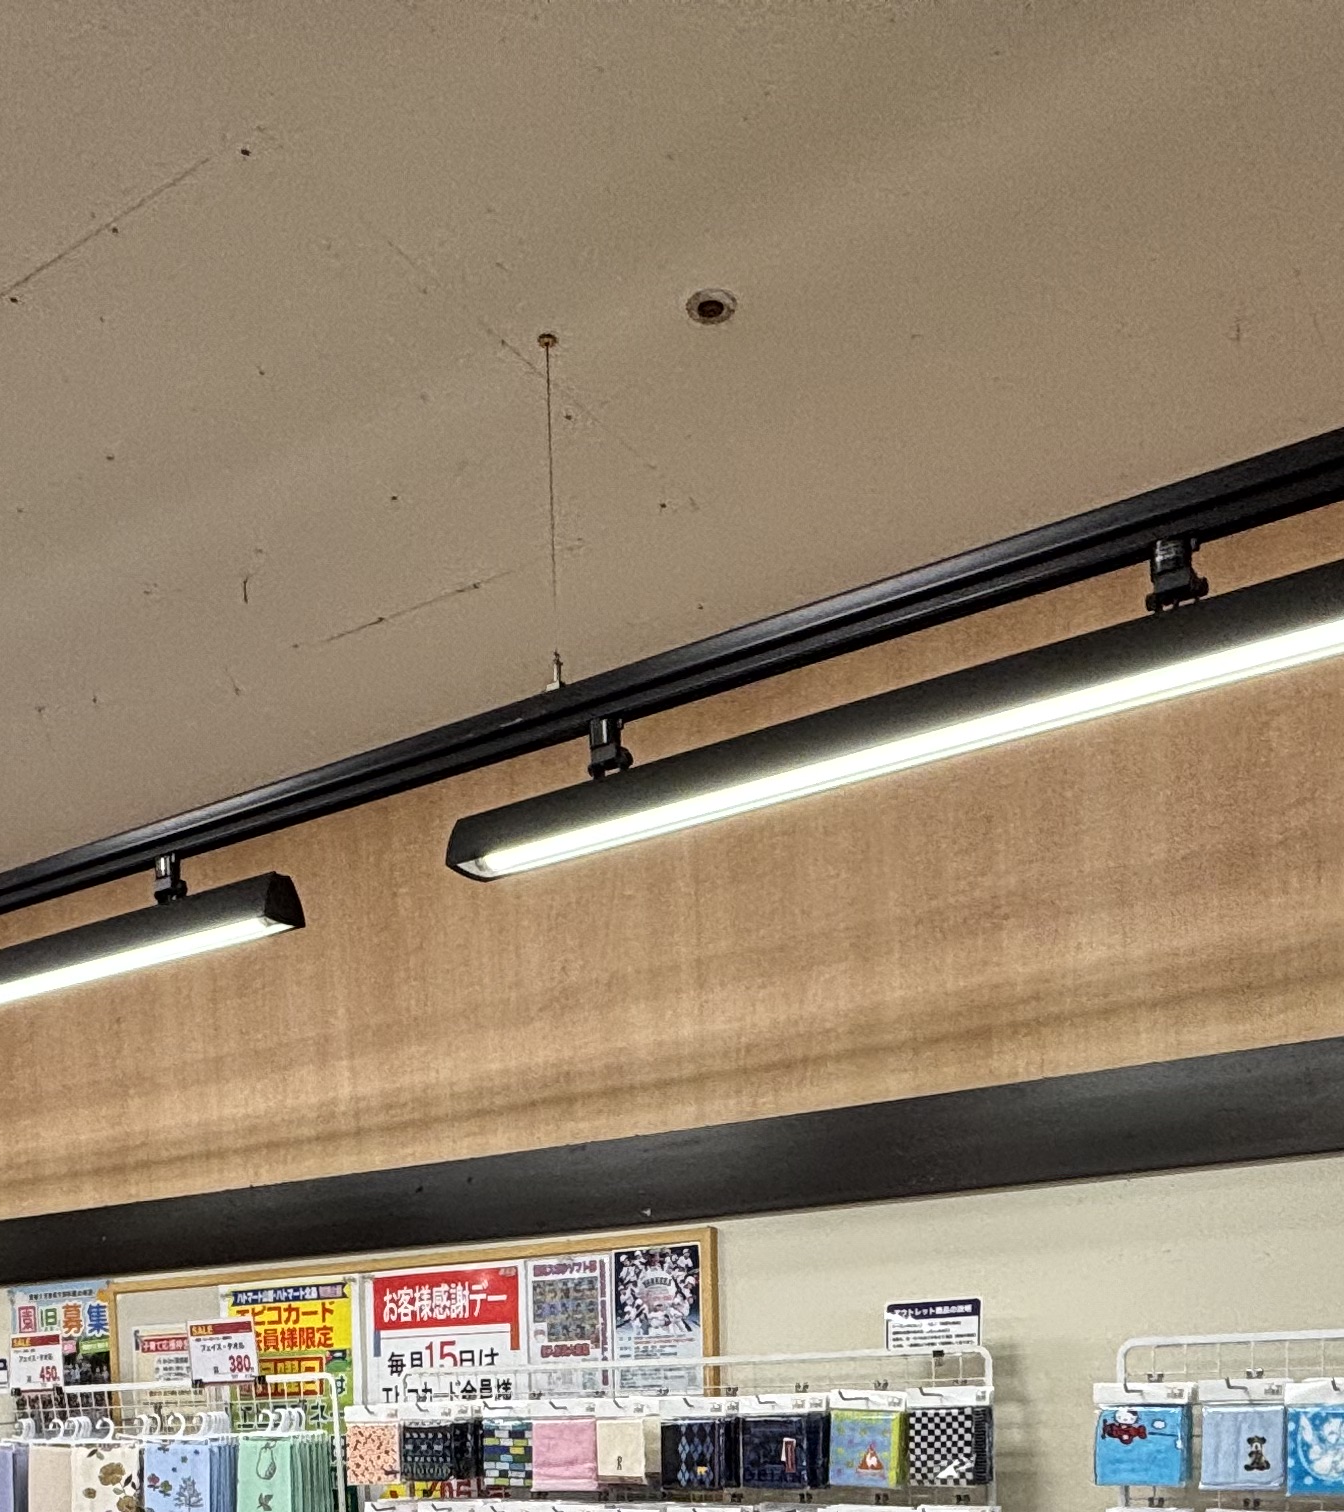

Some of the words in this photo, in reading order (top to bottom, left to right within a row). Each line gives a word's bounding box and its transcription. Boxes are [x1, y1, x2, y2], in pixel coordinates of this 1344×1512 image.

[383, 1280, 507, 1322] お客様感謝デー
